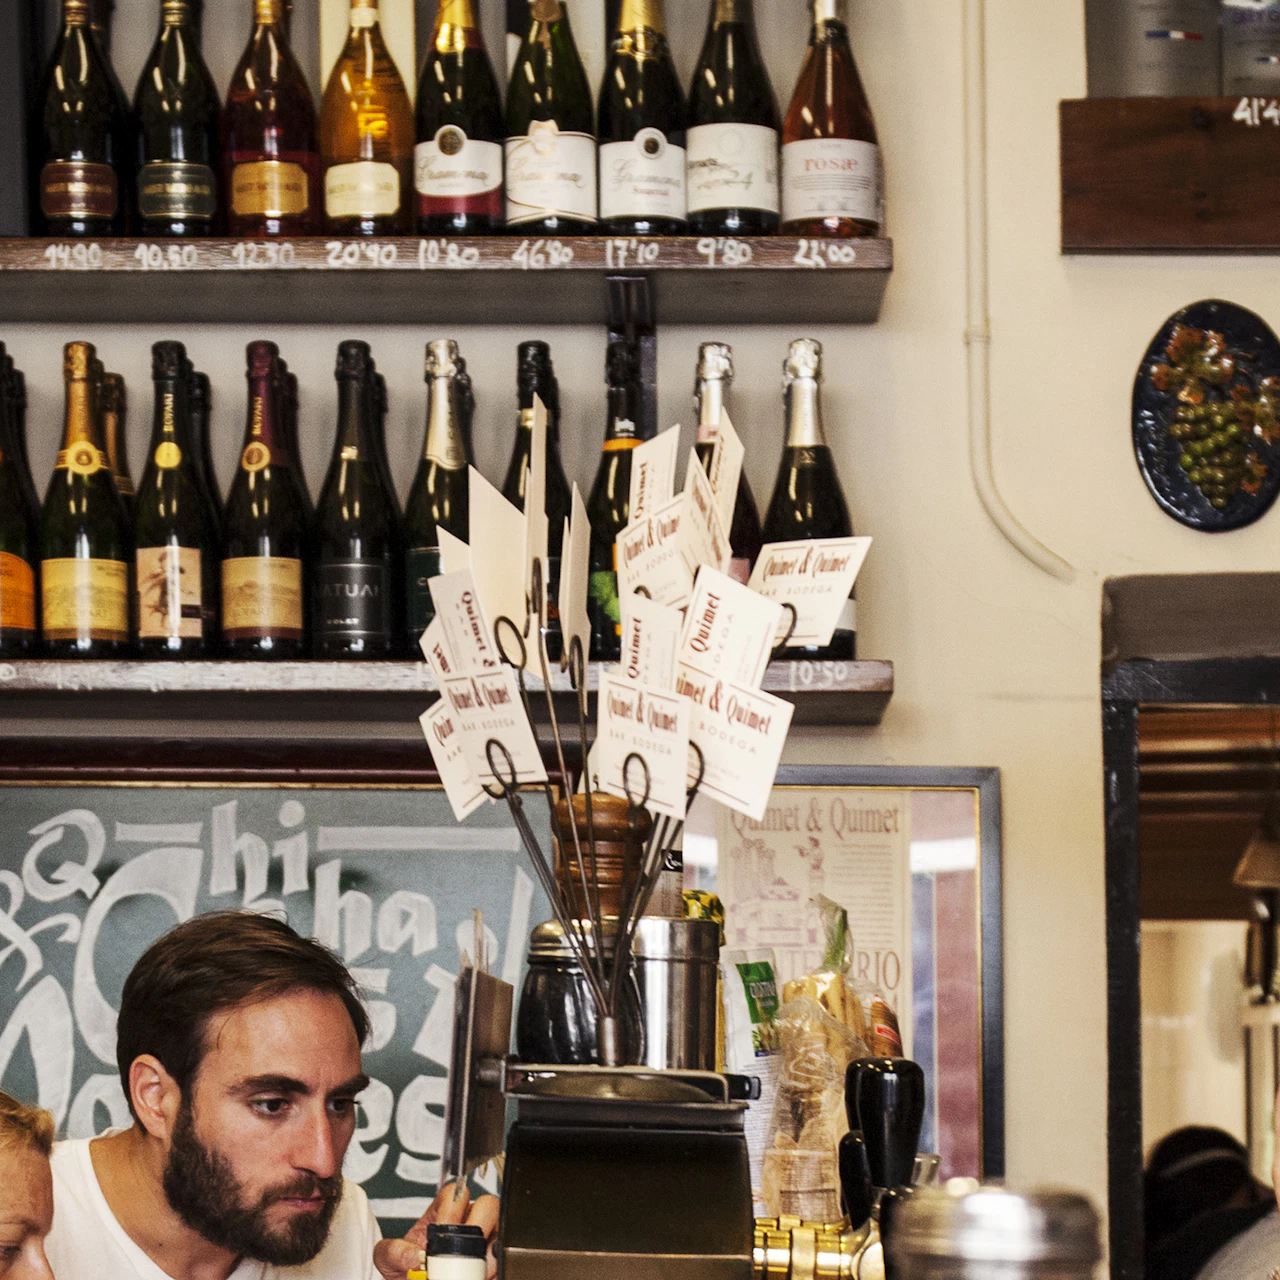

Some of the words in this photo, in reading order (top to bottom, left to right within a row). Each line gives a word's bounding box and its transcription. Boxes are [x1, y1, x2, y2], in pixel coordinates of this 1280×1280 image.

[762, 555, 799, 582] Quimet
[798, 545, 814, 575] &
[812, 552, 852, 579] Quimet
[460, 589, 488, 651] Quimet
[689, 590, 722, 653] Quimet
[627, 617, 643, 679] Quimet
[481, 681, 512, 713] Quimet
[606, 688, 635, 721] Quimet
[636, 690, 645, 725] &
[647, 698, 678, 734] Quimet
[708, 679, 724, 714] &
[726, 701, 772, 736] Quimet
[806, 796, 824, 832] &
[830, 797, 900, 841] Quimet
